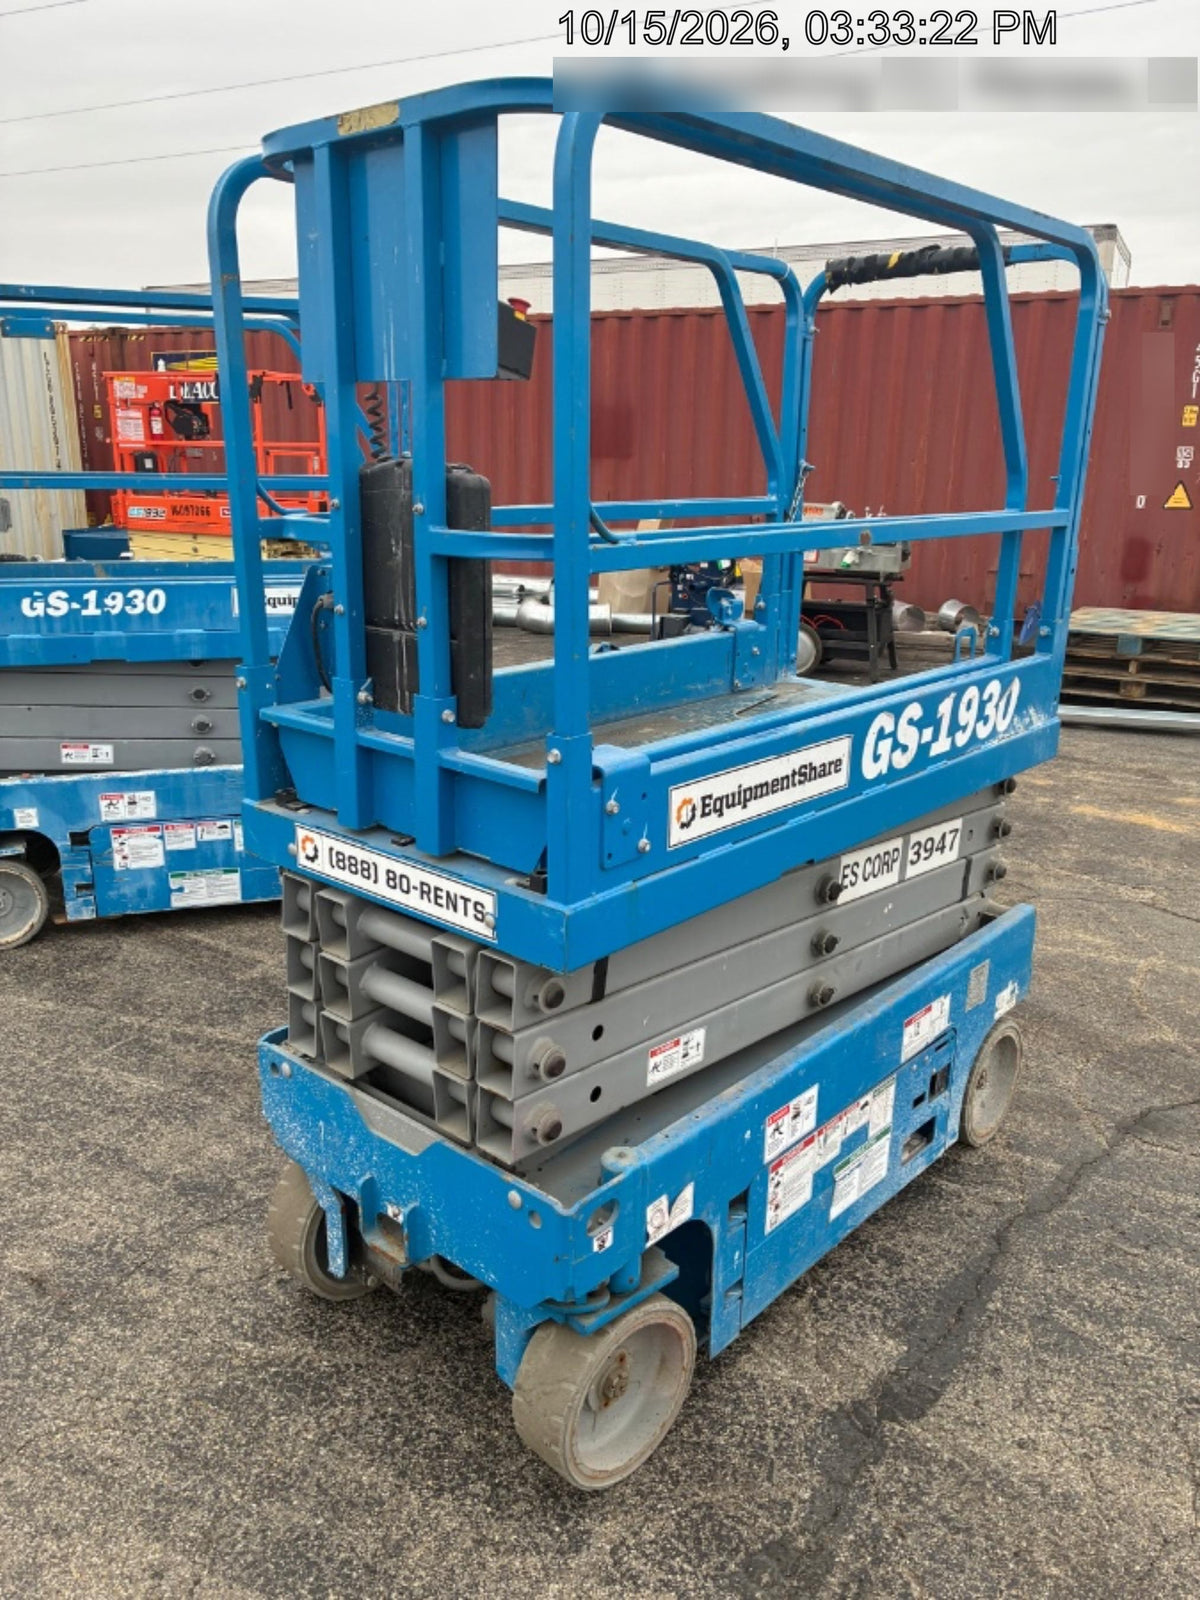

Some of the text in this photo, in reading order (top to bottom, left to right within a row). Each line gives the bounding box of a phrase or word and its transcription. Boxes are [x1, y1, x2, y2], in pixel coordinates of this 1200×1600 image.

[20, 588, 167, 618] GS-1930
[861, 676, 1021, 781] GS-1930
[700, 757, 843, 818] EquipmentShare
[840, 847, 900, 890] ES CORP
[909, 827, 959, 867] 3947
[328, 847, 486, 924] (888) 80-RENTS
